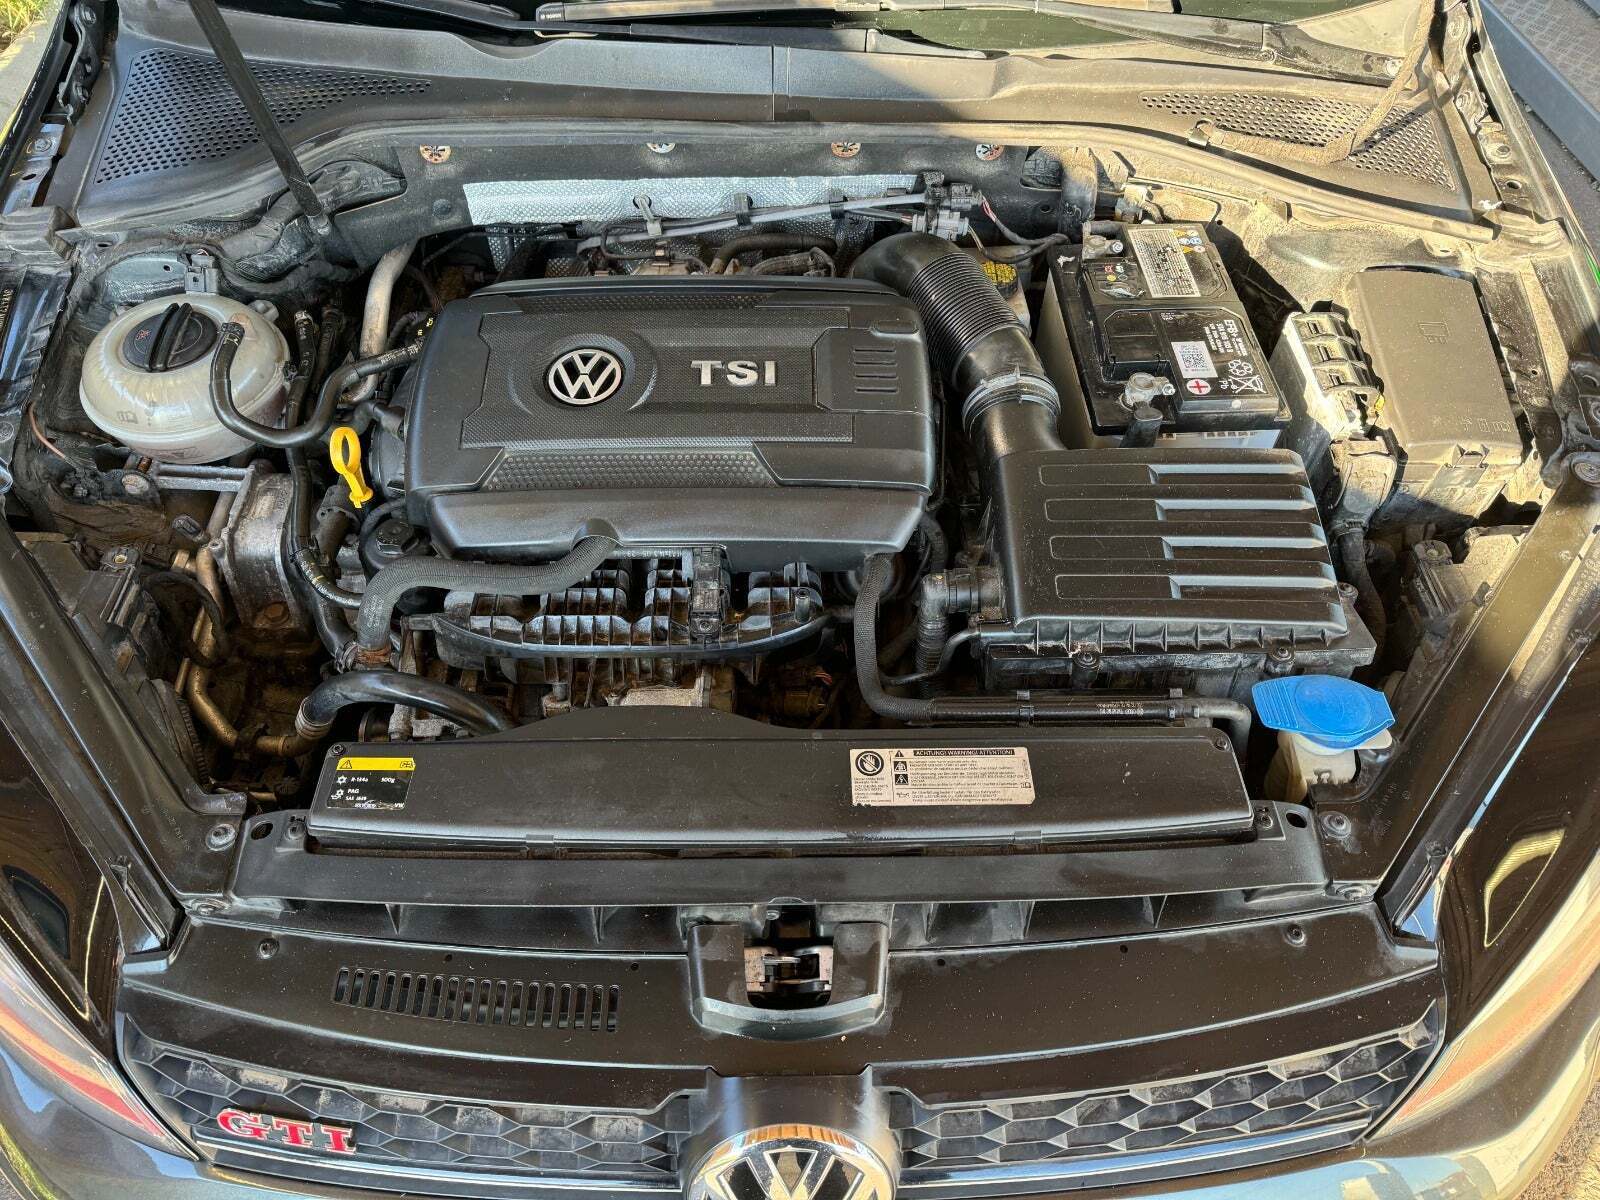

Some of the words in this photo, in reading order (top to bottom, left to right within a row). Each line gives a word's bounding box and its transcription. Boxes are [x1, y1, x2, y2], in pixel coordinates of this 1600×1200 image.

[549, 348, 622, 405] VW
[690, 360, 777, 387] TSI
[1218, 380, 1229, 390] Pb
[216, 1108, 356, 1155] GTI
